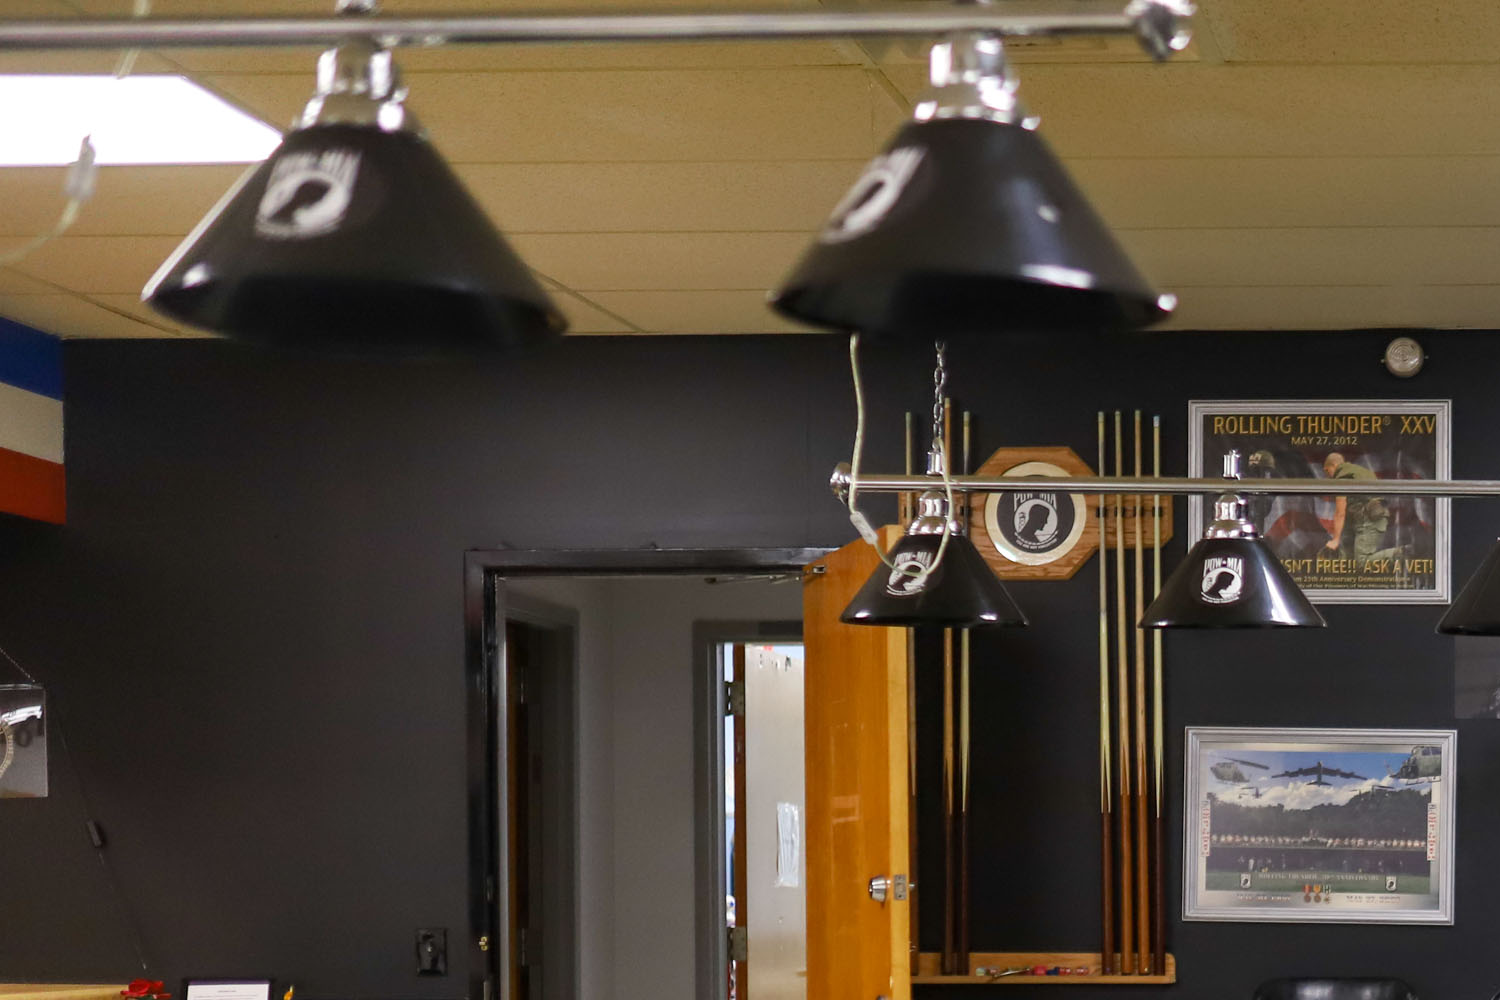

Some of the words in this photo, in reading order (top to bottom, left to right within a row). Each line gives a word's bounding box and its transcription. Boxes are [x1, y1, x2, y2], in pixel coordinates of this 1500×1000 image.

[1214, 416, 1292, 434] ROLLING
[1400, 416, 1436, 434] XXV
[1291, 436, 1313, 445] MAY
[1316, 436, 1331, 447] 27,
[1334, 436, 1358, 445] 2012
[1316, 559, 1357, 574] FREE!!
[1363, 559, 1390, 574] ASK
[1393, 559, 1402, 574] A
[1405, 559, 1433, 574] VET!
